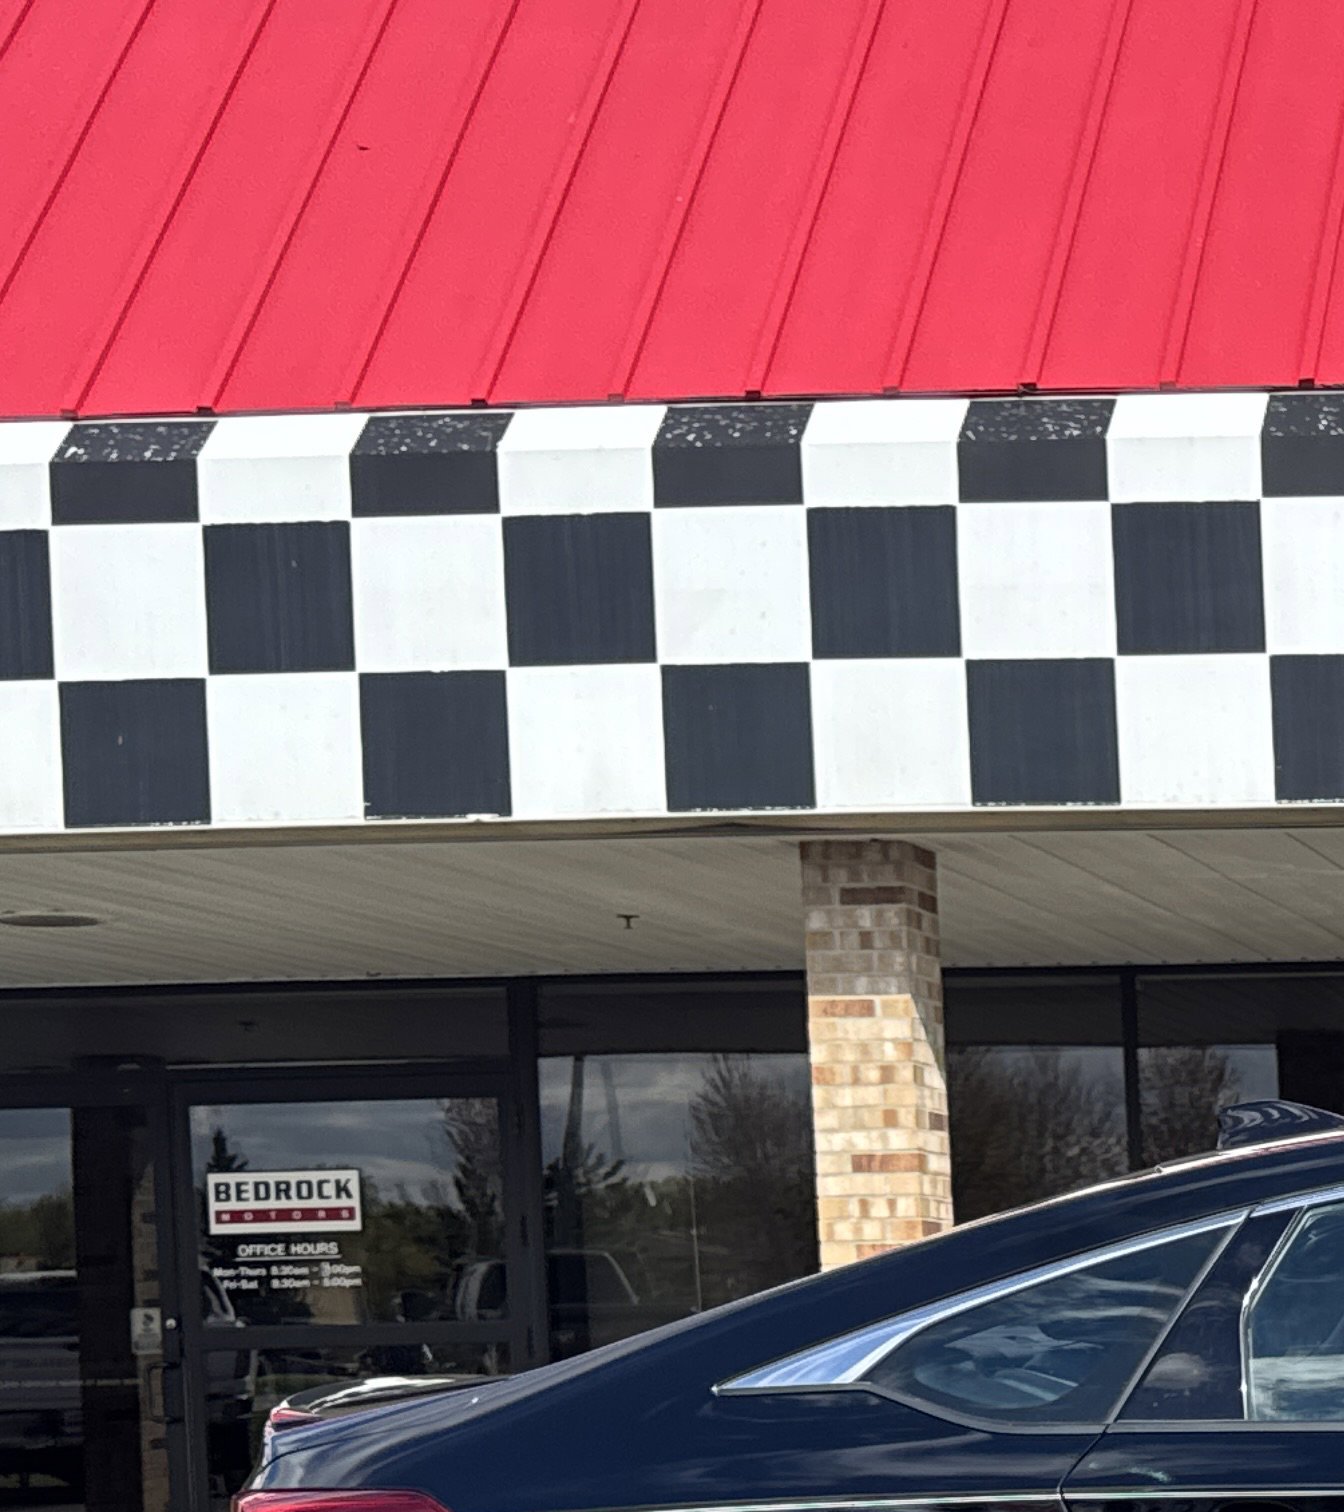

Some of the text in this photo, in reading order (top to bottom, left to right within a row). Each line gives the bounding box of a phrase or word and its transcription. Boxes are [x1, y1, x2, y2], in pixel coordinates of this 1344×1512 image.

[214, 1178, 354, 1202] BEDROCK
[220, 1209, 351, 1222] MOTORS
[237, 1241, 339, 1257] OFFICE HOURS
